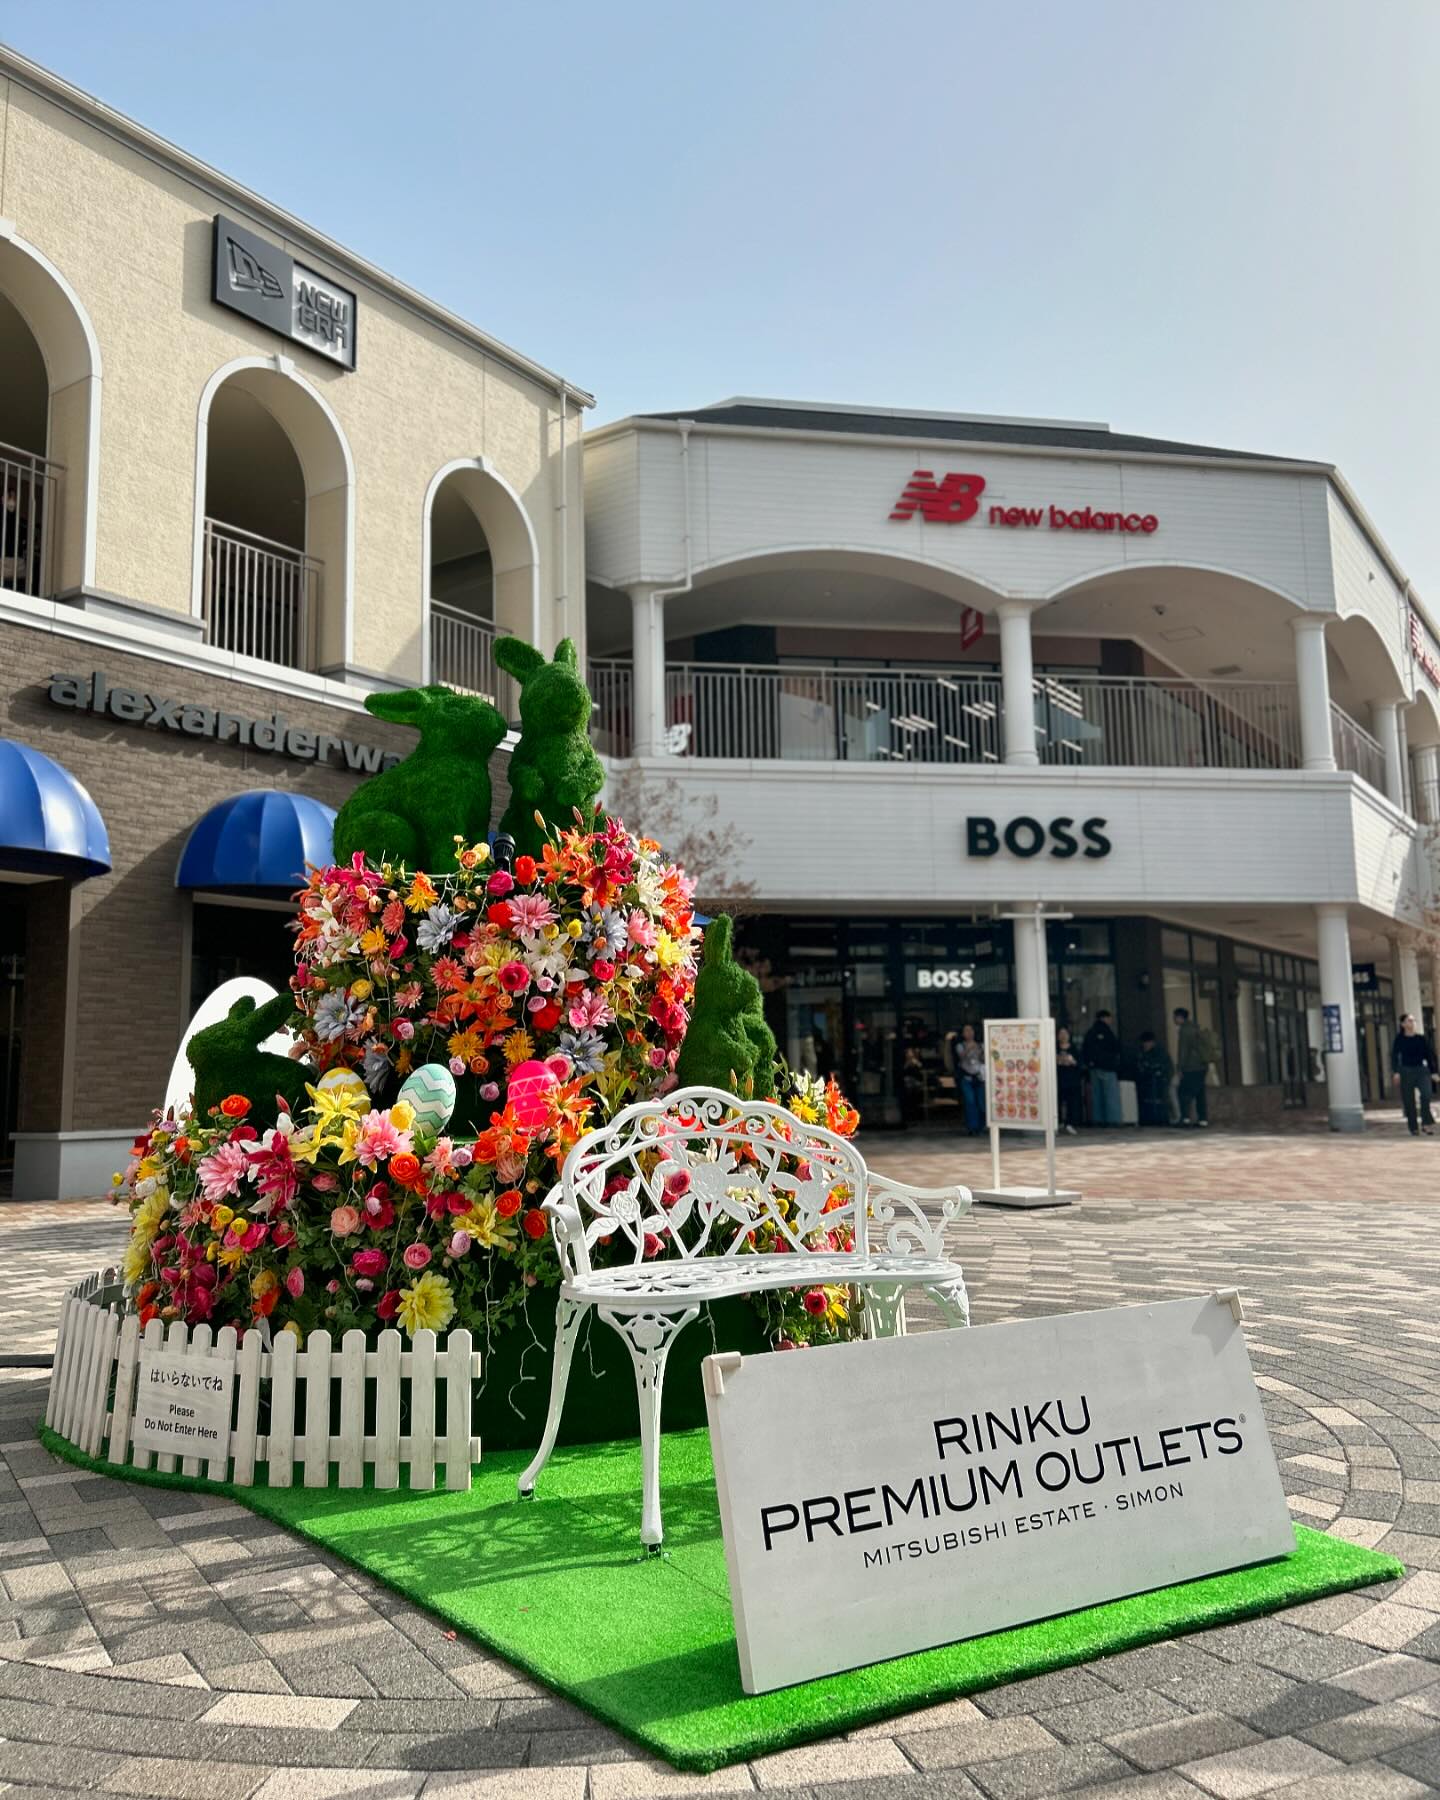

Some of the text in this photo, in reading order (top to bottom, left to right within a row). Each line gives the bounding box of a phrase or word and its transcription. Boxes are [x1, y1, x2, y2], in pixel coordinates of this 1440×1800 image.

[300, 281, 348, 323] NEW
[299, 306, 347, 349] ERA
[989, 505, 1159, 534] new balance
[966, 816, 1112, 859] BOSS
[917, 969, 974, 988] BOSS
[150, 1368, 224, 1392] はいらないでね
[144, 1418, 218, 1440] Do Not Enter Here
[169, 1404, 195, 1418] Please
[933, 1395, 1092, 1460] RINKU
[760, 1459, 1024, 1551] PREMIUM
[863, 1520, 1008, 1569] MITSUBISHI
[1015, 1502, 1097, 1534] ESTATE
[1116, 1481, 1184, 1511] SIMON
